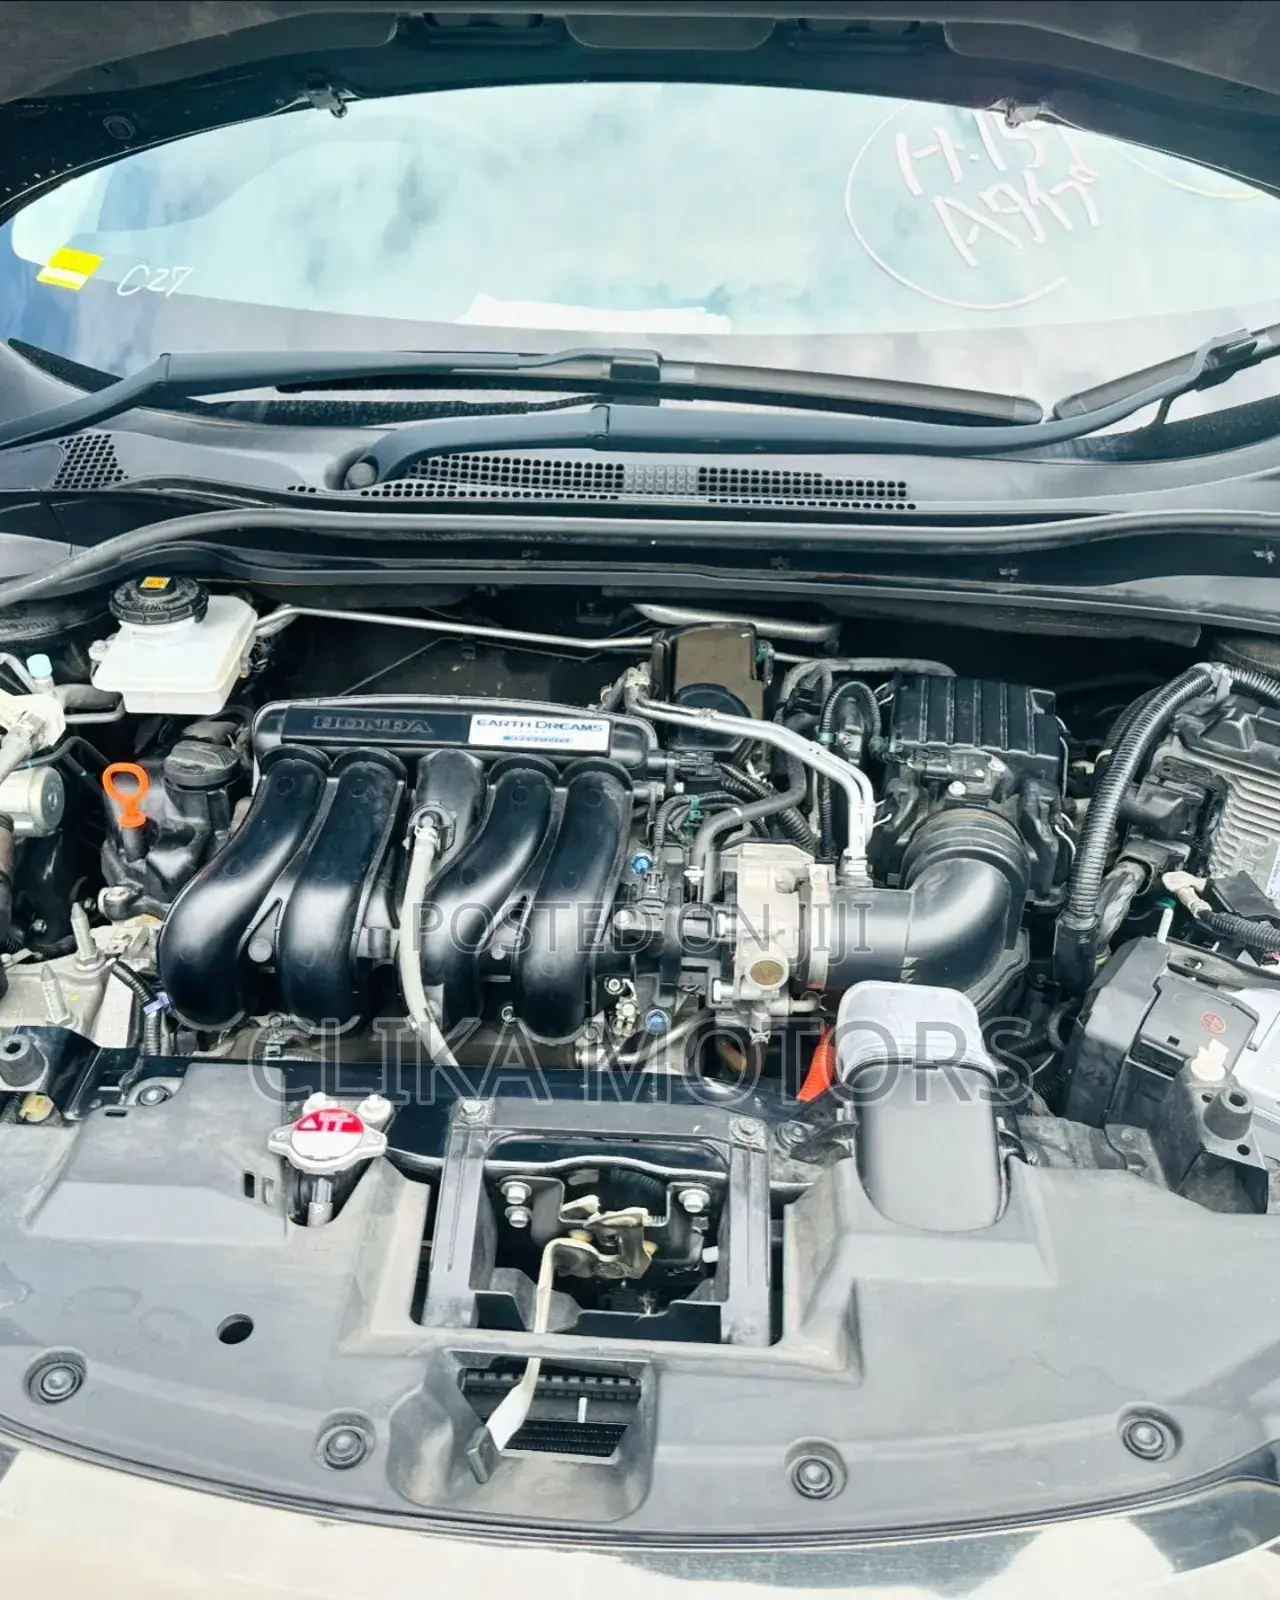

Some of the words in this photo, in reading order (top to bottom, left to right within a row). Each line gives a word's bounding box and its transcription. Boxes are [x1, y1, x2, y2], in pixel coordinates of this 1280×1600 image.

[116, 264, 194, 298] C27
[312, 715, 433, 733] HONDA
[476, 718, 532, 729] EARTH
[535, 720, 604, 732] DREAMS
